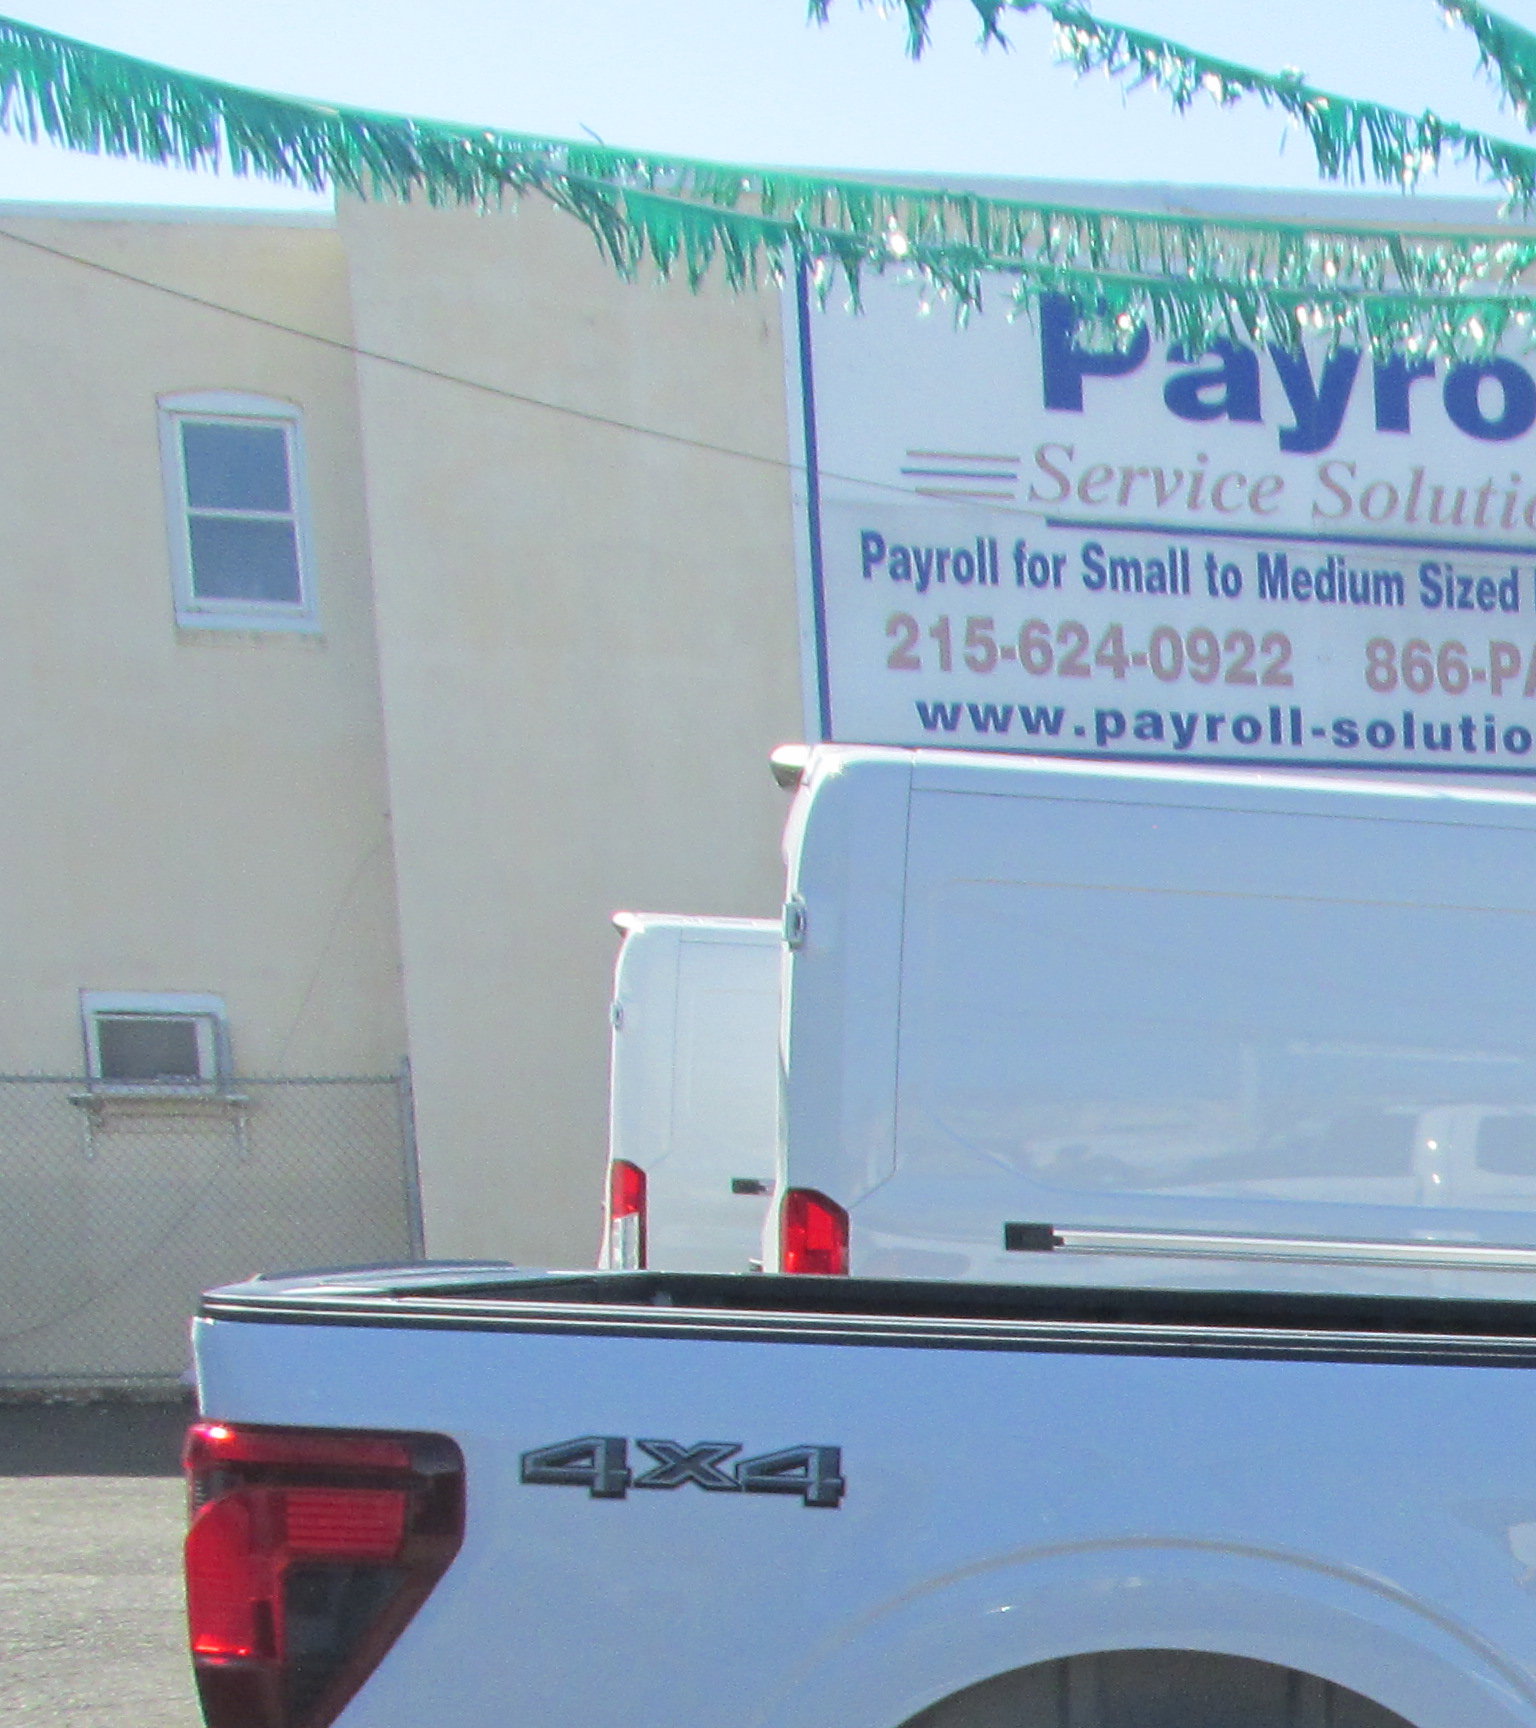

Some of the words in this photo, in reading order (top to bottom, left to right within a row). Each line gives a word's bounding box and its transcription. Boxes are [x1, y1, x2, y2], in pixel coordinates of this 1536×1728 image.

[1027, 441, 1285, 516] Service
[859, 528, 999, 593] Payroll
[1012, 538, 1067, 588] for
[1080, 541, 1190, 595] Small
[1204, 551, 1243, 598] to
[1256, 551, 1405, 607] Medium
[1418, 560, 1520, 613] Sized
[885, 612, 1295, 689] 215-624-0922
